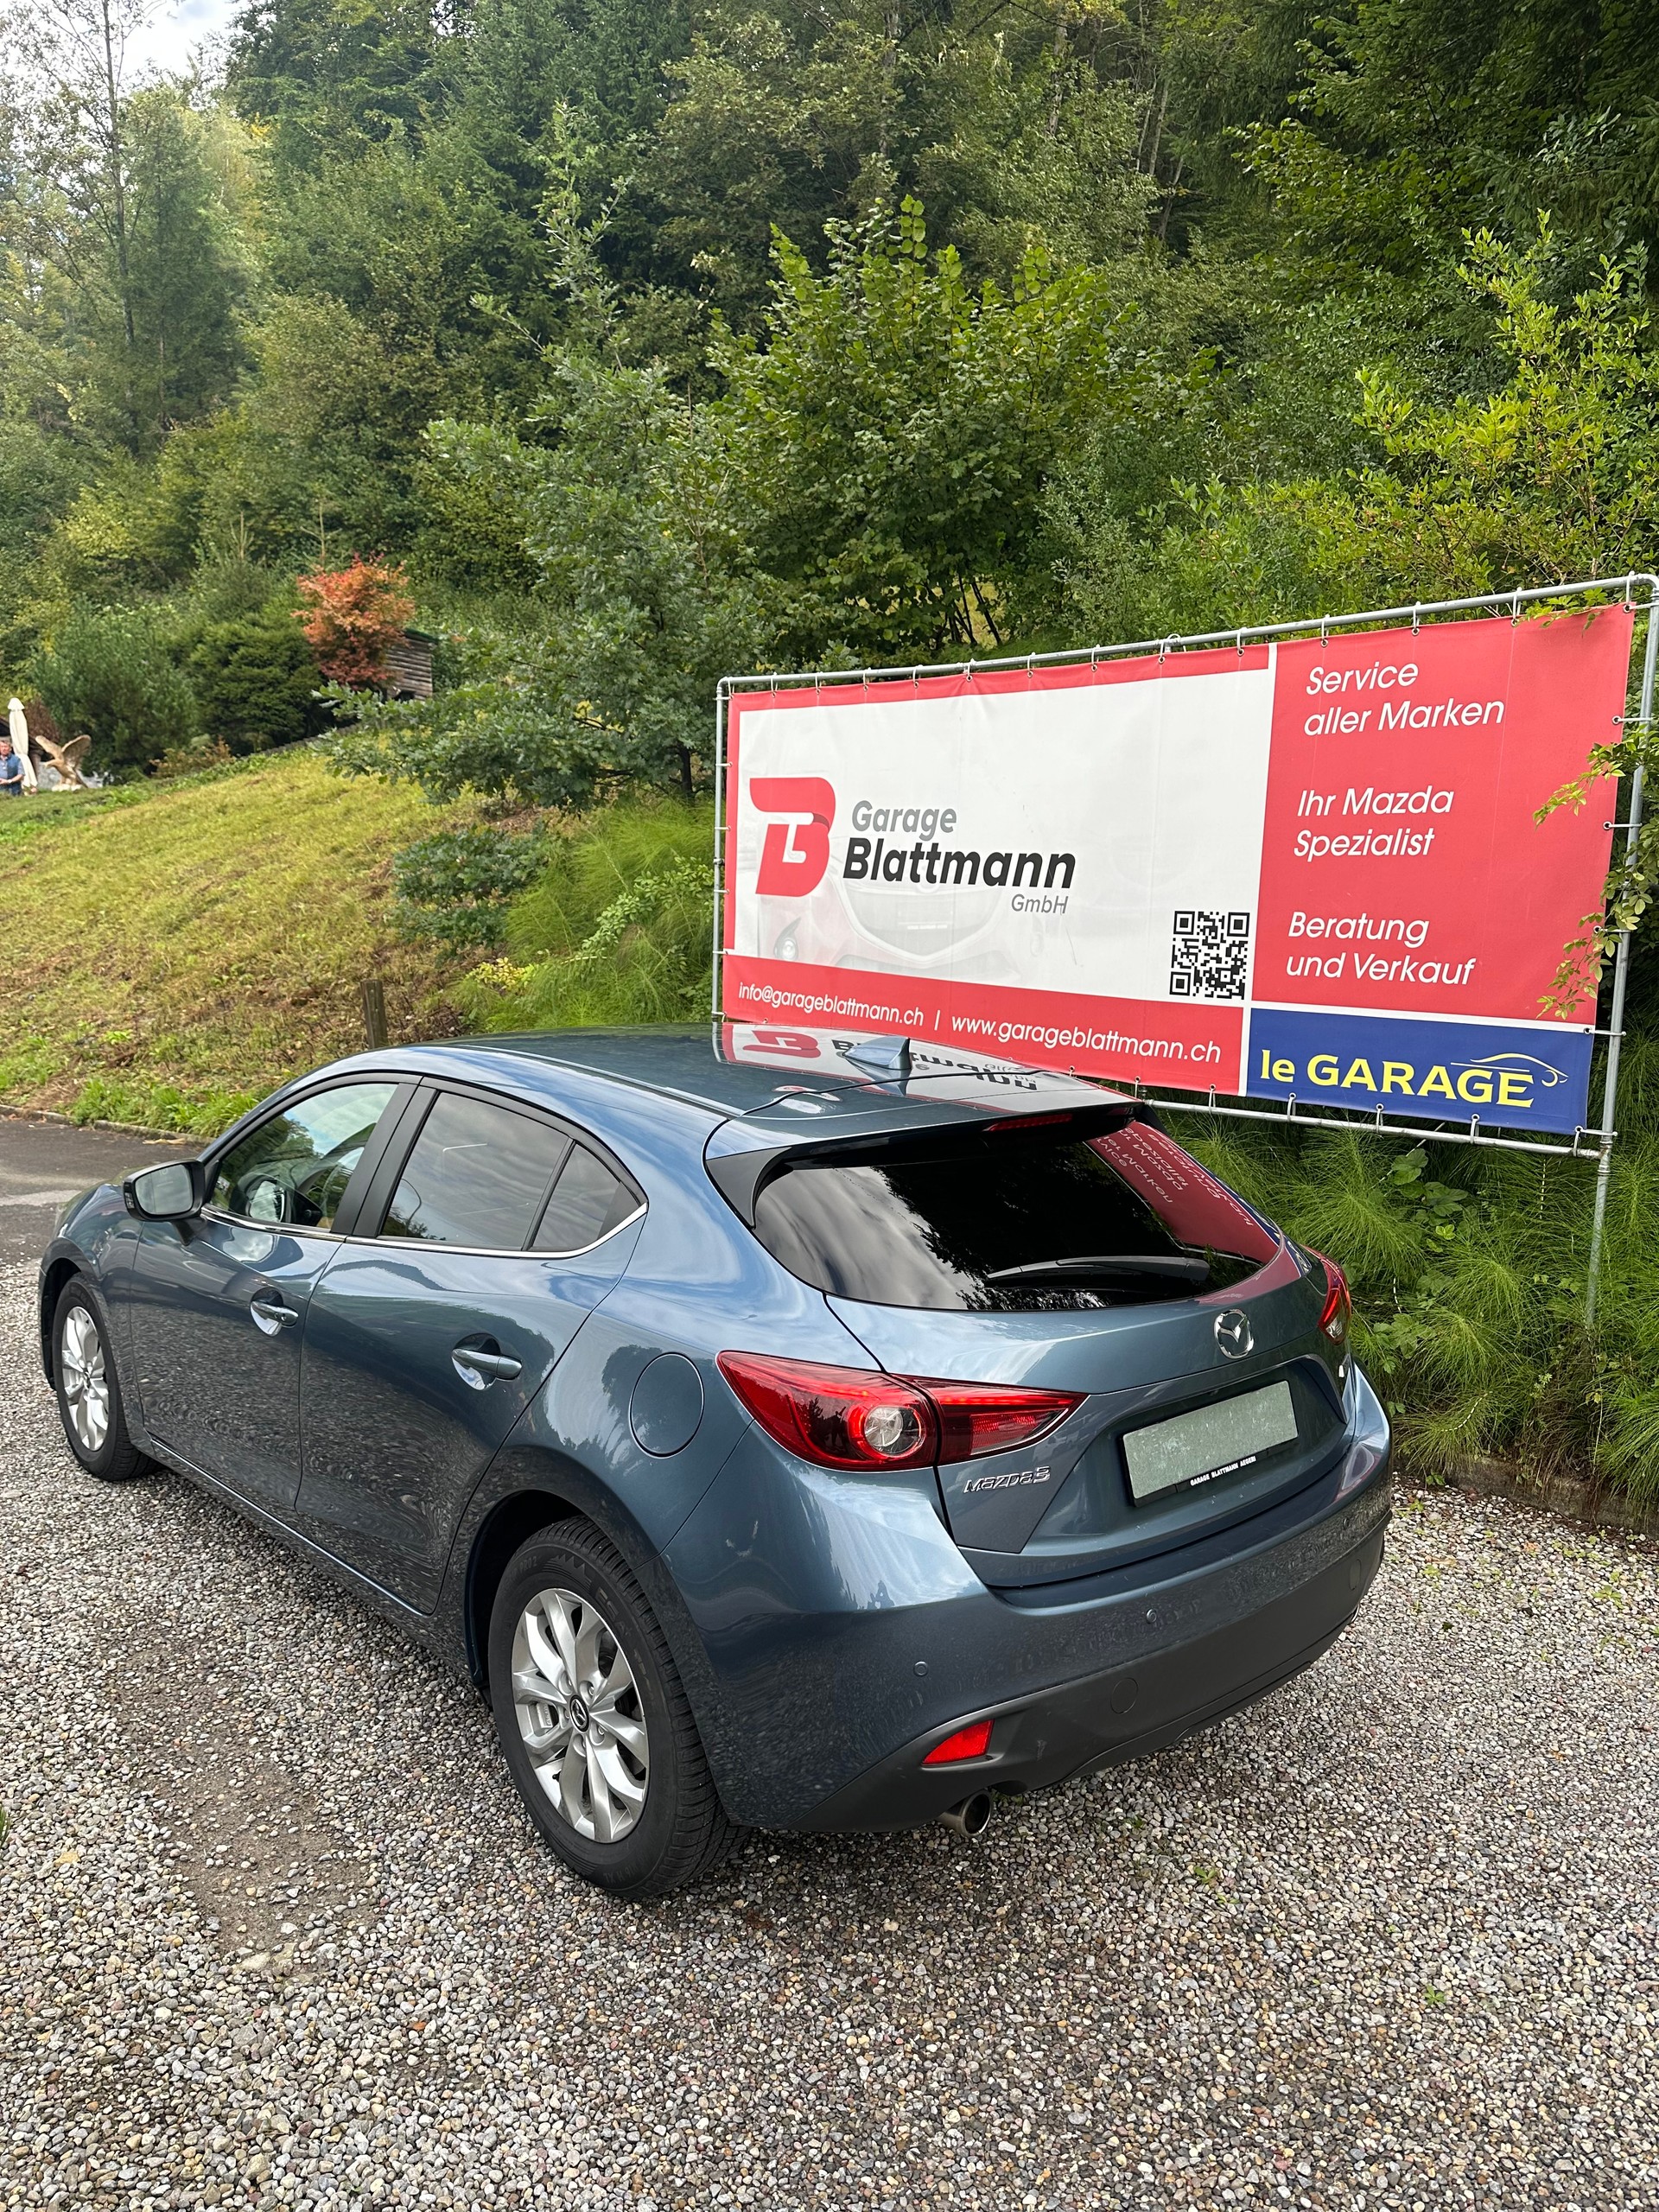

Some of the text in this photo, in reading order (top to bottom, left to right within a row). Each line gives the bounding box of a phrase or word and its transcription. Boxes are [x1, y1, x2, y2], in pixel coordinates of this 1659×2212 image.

[1306, 661, 1420, 696] Service
[1303, 697, 1505, 737] aller Marken
[1297, 785, 1455, 817] Ihr Mazda
[849, 799, 957, 842] Garage
[1294, 827, 1436, 862] Spezialist
[842, 836, 1077, 890] Blattmann
[1010, 893, 1069, 915] GmbH
[1287, 911, 1430, 949] Beratung
[1285, 952, 1477, 986] und Verkauf
[738, 981, 1223, 1065] info@garageblattmann.ch www.garageblattmann.ch
[1260, 1049, 1535, 1109] le GARAGE
[1190, 1472, 1211, 1486] GARAGE
[1211, 1462, 1239, 1478] BLATTMANN
